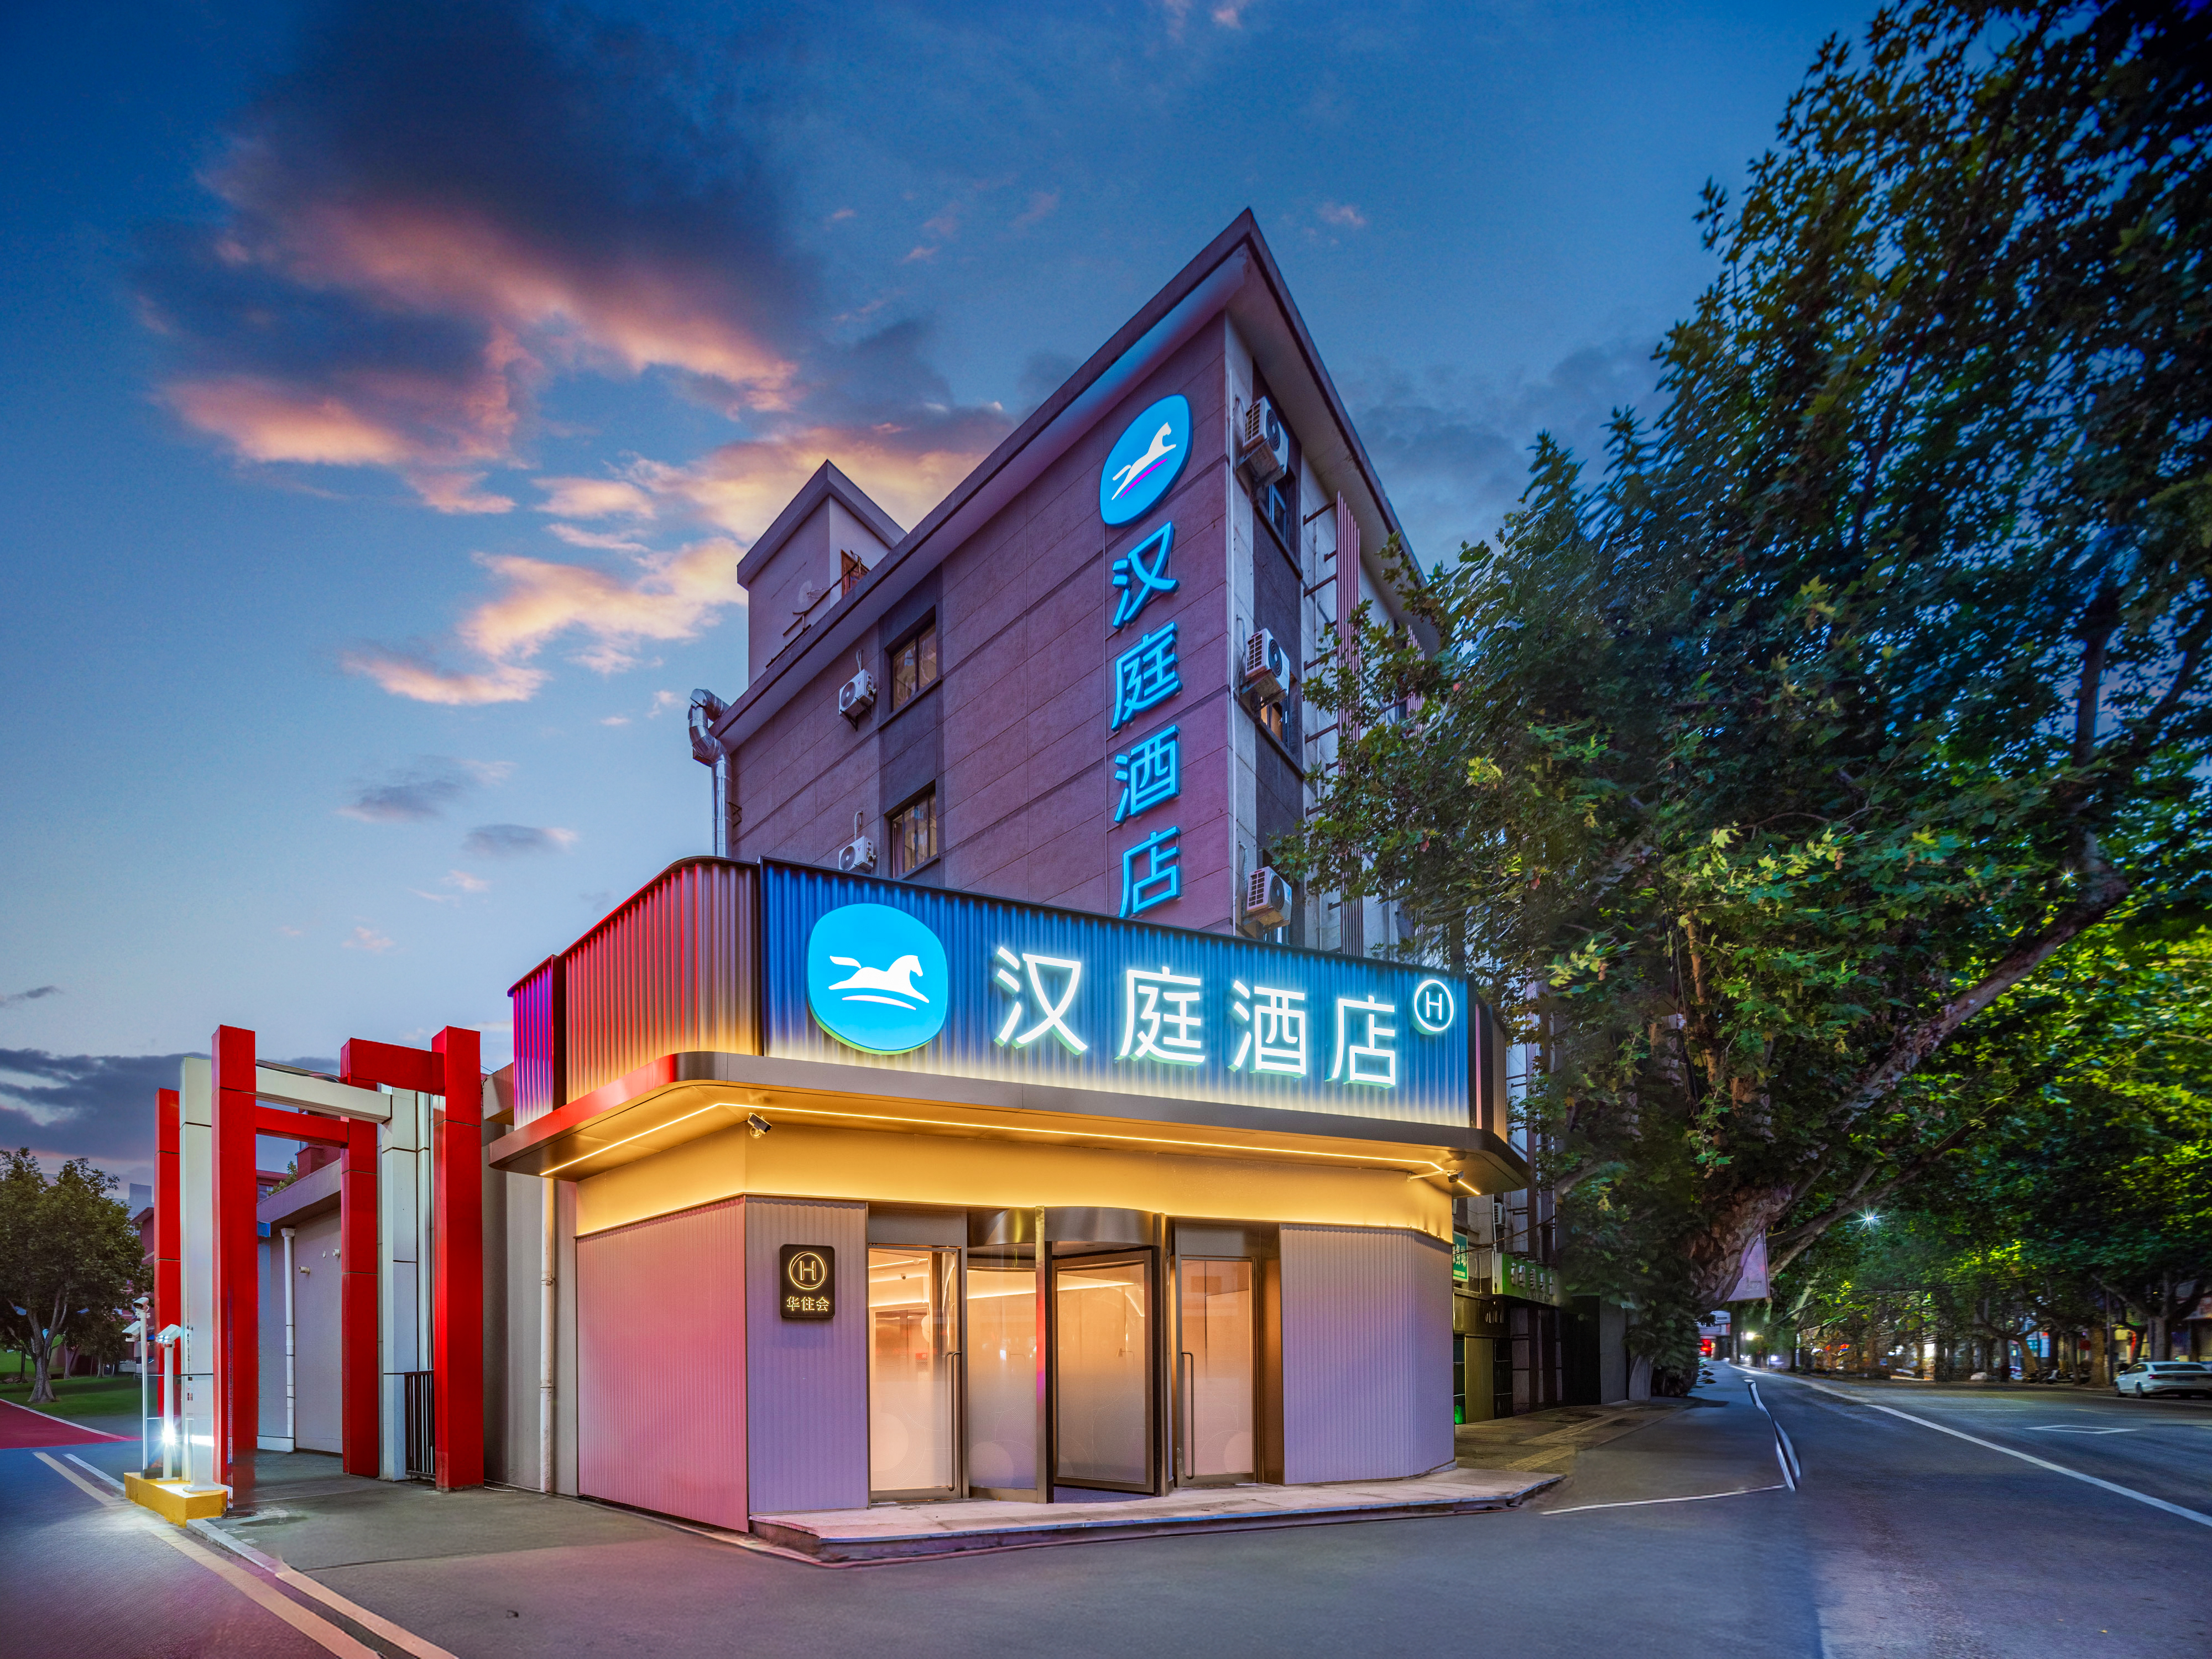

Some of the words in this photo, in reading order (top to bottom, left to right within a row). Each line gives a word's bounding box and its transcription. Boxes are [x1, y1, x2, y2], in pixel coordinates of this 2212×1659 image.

[1112, 520, 1182, 917] 汉庭酒店
[995, 946, 1397, 1088] 汉庭酒店
[786, 1296, 830, 1312] 华住会
